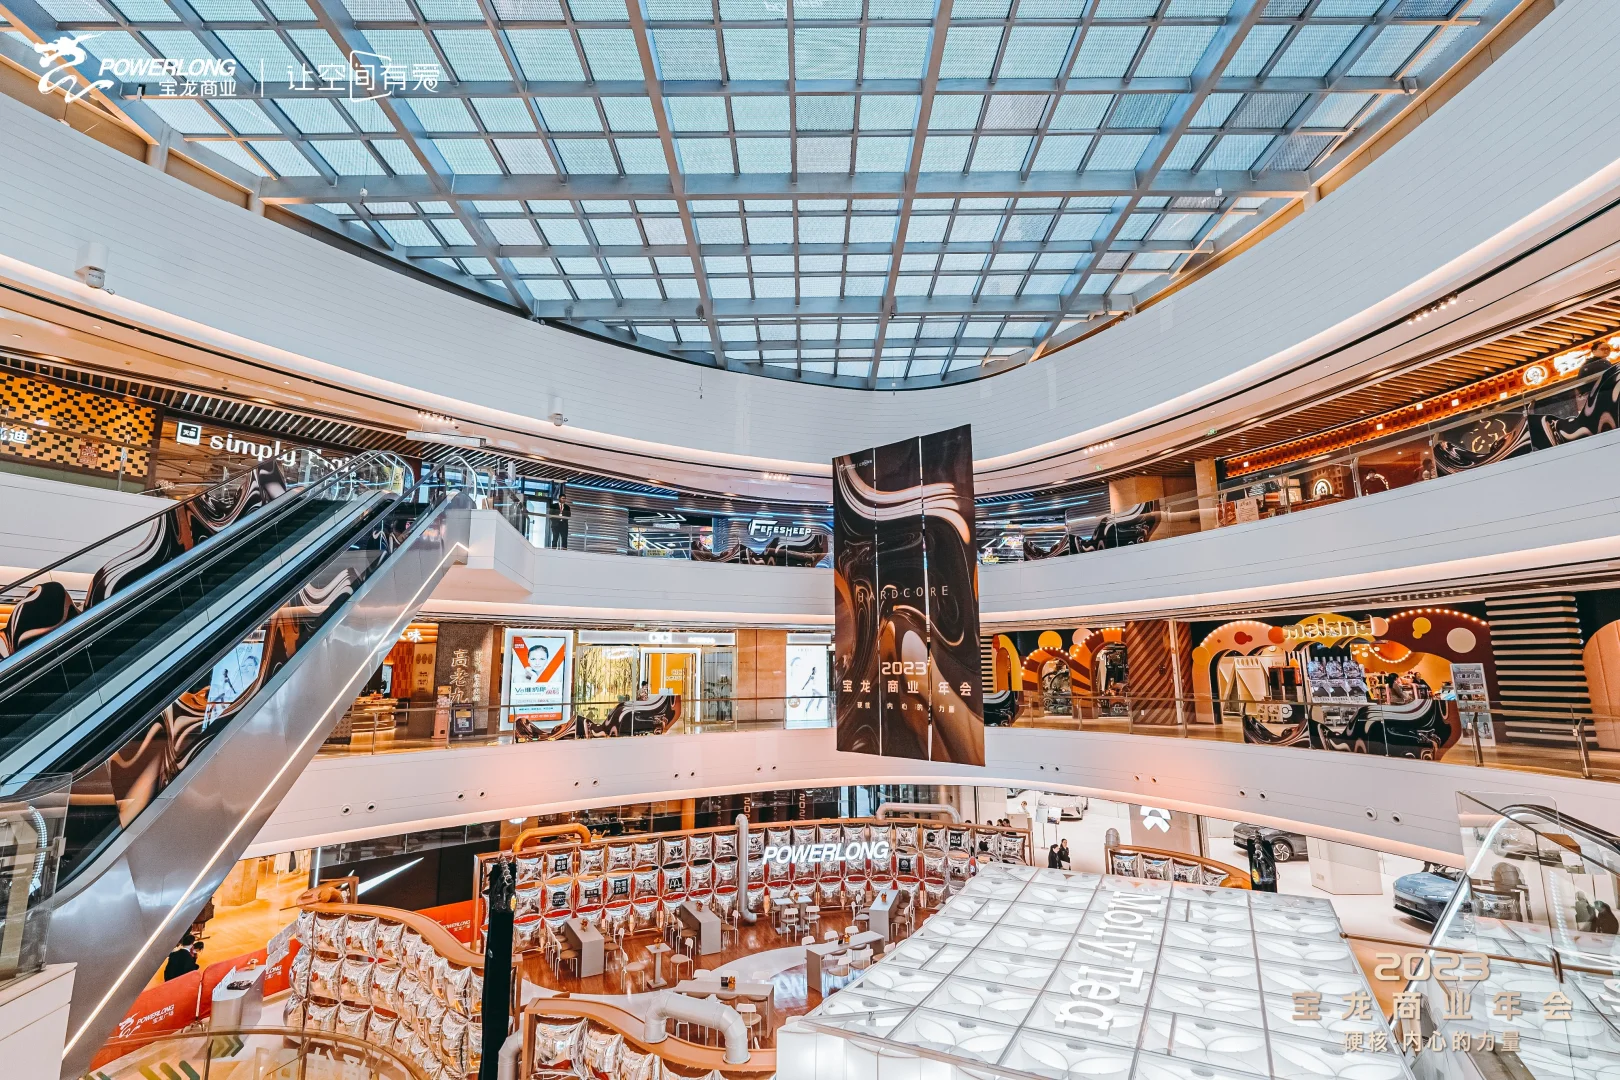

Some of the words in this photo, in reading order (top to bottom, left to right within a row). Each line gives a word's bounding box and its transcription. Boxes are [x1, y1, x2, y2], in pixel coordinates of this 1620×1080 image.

[209, 433, 297, 467] simply
[857, 585, 949, 602] HARDCORE
[881, 661, 927, 675] 2023
[842, 679, 972, 697] 宝龙商业年会
[762, 841, 890, 865] POWERLONG
[136, 1004, 175, 1026] POWERLONG
